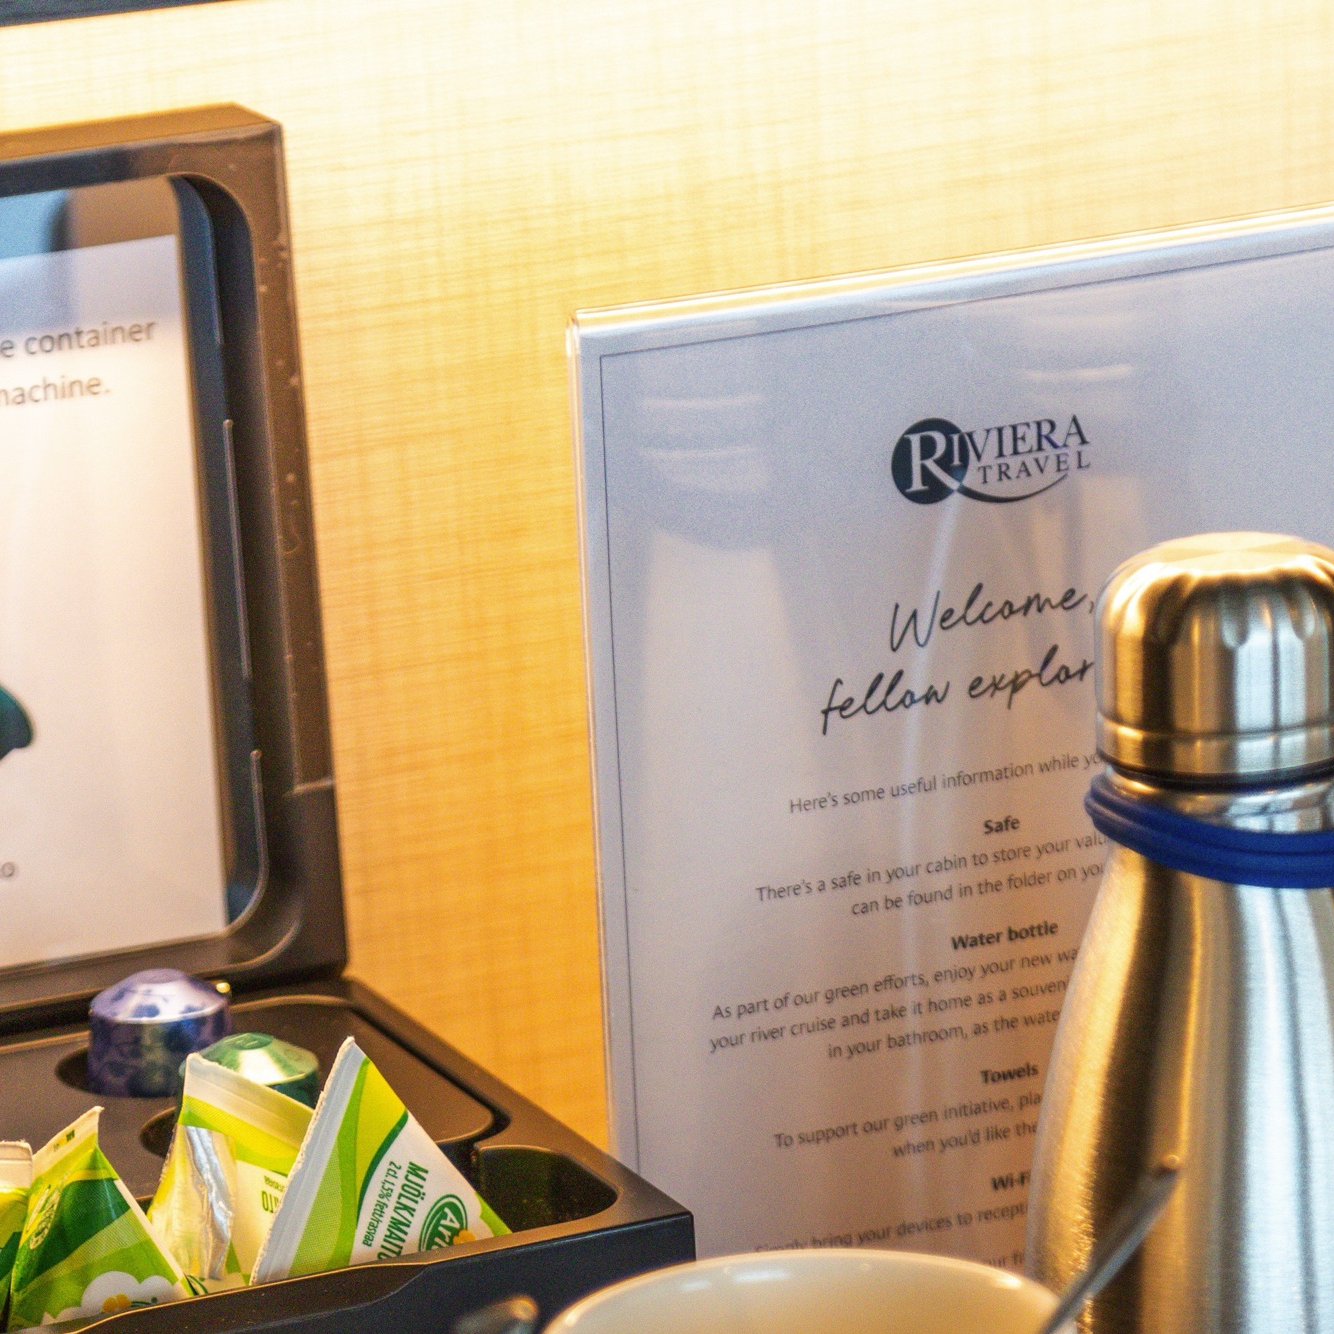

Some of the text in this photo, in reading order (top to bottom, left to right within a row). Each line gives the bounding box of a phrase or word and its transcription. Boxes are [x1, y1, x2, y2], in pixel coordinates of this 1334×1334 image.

[24, 319, 157, 356] container
[904, 414, 1090, 493] RIVIERA
[978, 450, 1091, 484] TRAVEL
[890, 583, 1095, 652] Welcome,
[821, 644, 1095, 735] fellow explor
[789, 792, 839, 814] Here's
[843, 788, 885, 804] some
[891, 775, 937, 798] useful
[942, 762, 1034, 789] information
[1039, 753, 1079, 773] while
[984, 816, 1021, 834] Safe
[755, 878, 813, 904] There's
[818, 881, 826, 892] a
[831, 871, 861, 890] safe
[867, 867, 881, 883] in
[885, 864, 922, 883] your
[926, 853, 967, 874] cabin
[971, 851, 988, 867] to
[993, 845, 1031, 864] store
[1034, 839, 1071, 860] your
[852, 899, 879, 916] can
[885, 894, 903, 910] be
[907, 884, 953, 906] found
[959, 883, 973, 898] in
[978, 878, 1003, 895] the
[1007, 871, 1051, 890] folder
[1057, 867, 1076, 882] on
[951, 920, 1059, 951] Water bottle
[713, 1006, 731, 1020] As
[737, 1000, 769, 1019] part
[774, 991, 790, 1010] of
[793, 991, 820, 1007] our
[825, 982, 868, 1005] green
[874, 971, 929, 996] efforts,
[934, 964, 976, 985] enjoy
[979, 959, 1016, 979] your
[1020, 953, 1052, 969] new
[709, 976, 1069, 1054] your river cruise and take it home as a souveni
[828, 1009, 1059, 1059] in your bathroom, as the wate
[981, 1063, 1039, 1084] Towels
[774, 1132, 793, 1148] To
[798, 1123, 858, 1145] support
[862, 1118, 891, 1134] our
[894, 1110, 939, 1130] green
[944, 1097, 1014, 1120] initiative,
[893, 1139, 936, 1158] when
[985, 1125, 1011, 1142] like
[388, 1160, 402, 1171] 2
[991, 1169, 1031, 1191] Wi-F
[811, 1232, 852, 1248] bring
[858, 1228, 891, 1245] your
[896, 1217, 952, 1237] devices
[956, 1212, 973, 1226] to
